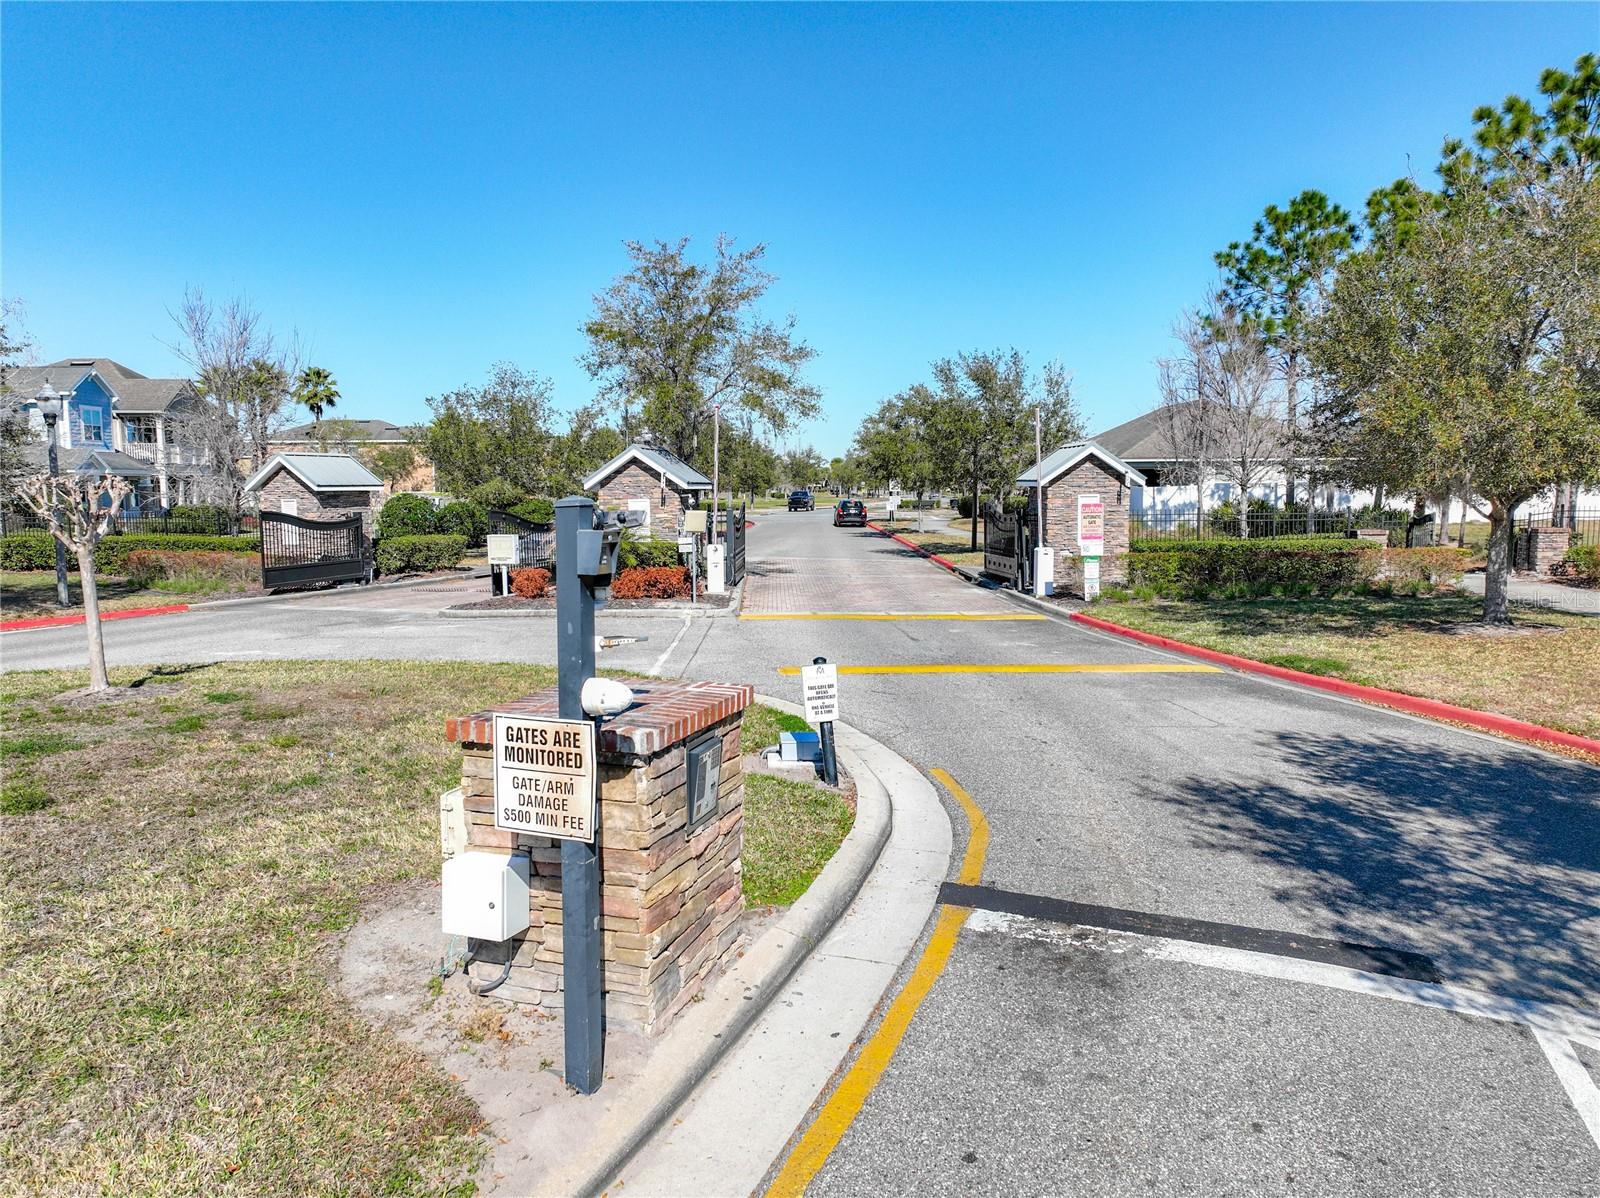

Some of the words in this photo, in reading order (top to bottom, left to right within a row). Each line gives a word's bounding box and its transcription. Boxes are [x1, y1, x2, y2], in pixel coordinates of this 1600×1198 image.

[506, 726, 548, 746] GATES
[553, 730, 580, 748] ARE
[504, 746, 583, 769] MONITORED
[512, 776, 574, 796] GATE/ARM
[518, 794, 568, 812] DAMAGE
[504, 808, 531, 824] $500
[536, 812, 558, 827] MIN
[563, 816, 584, 830] FEE
